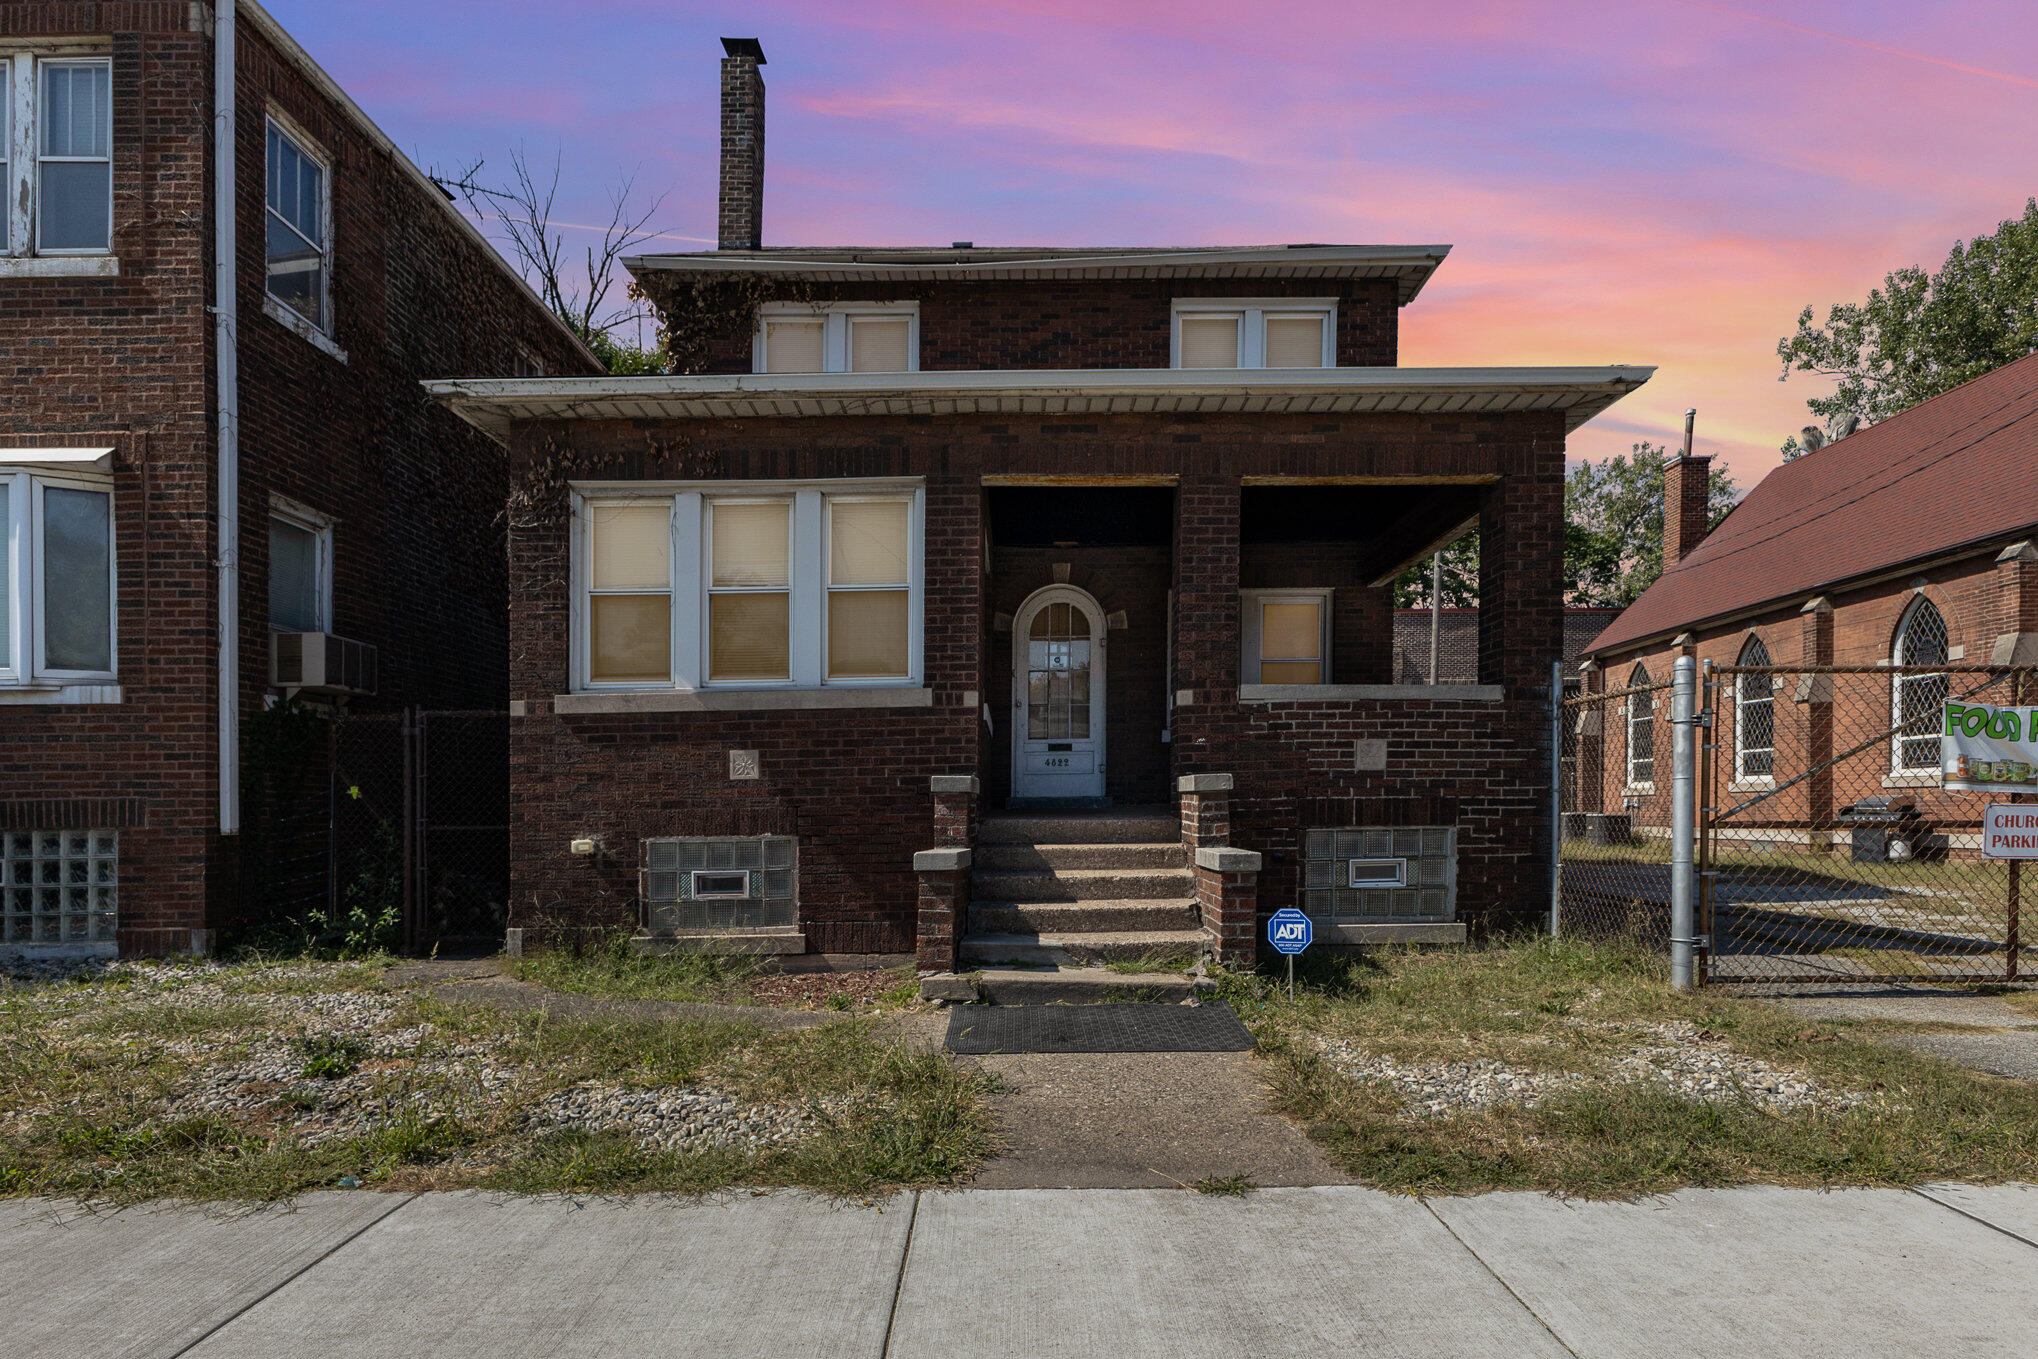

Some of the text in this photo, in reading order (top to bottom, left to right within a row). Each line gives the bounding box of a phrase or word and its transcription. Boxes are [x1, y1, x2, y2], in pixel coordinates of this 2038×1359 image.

[1945, 703, 2021, 742] FOOD
[1994, 814, 2038, 828] CHUR
[1992, 834, 2038, 848] PARKI
[1276, 923, 1305, 939] ADT
